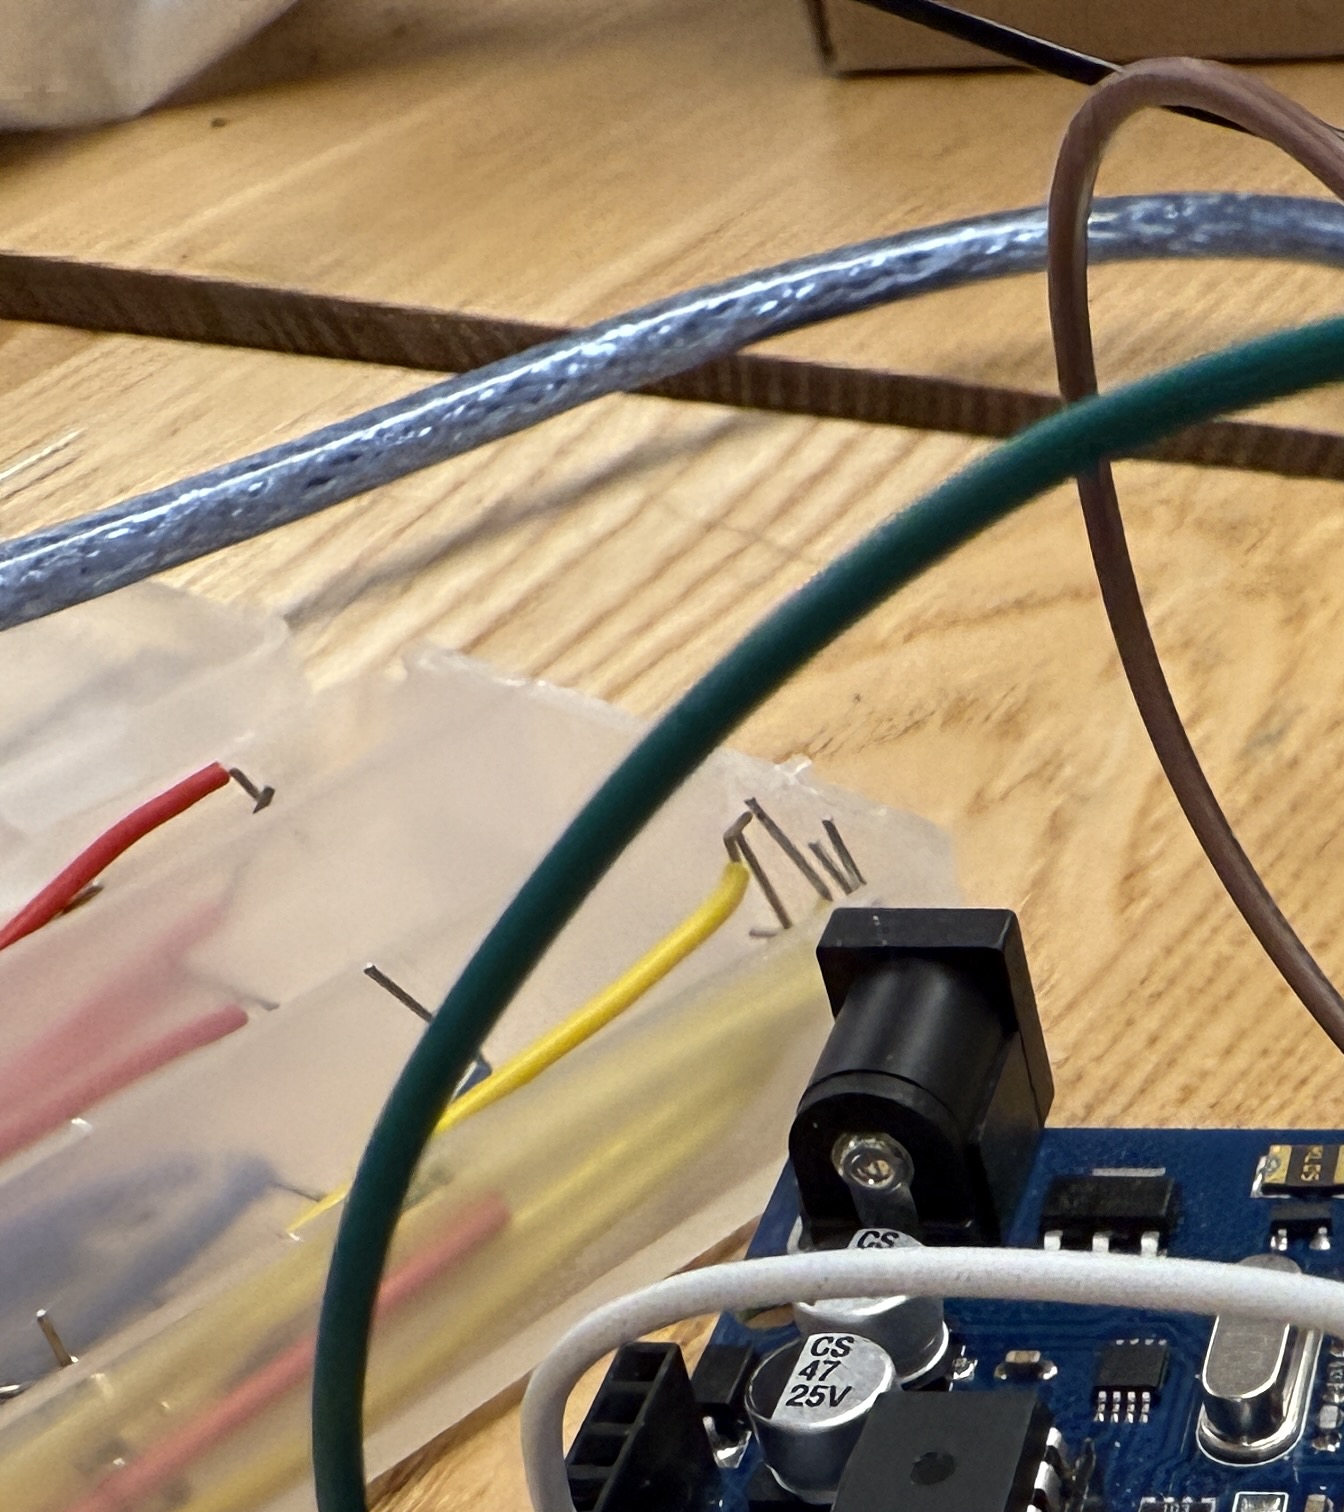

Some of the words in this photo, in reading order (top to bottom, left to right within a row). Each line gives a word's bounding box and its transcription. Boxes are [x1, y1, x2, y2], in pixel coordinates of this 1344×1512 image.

[857, 1231, 900, 1249] CS
[810, 1336, 855, 1358] CS
[799, 1360, 841, 1381] 47
[785, 1385, 852, 1408] 25V
